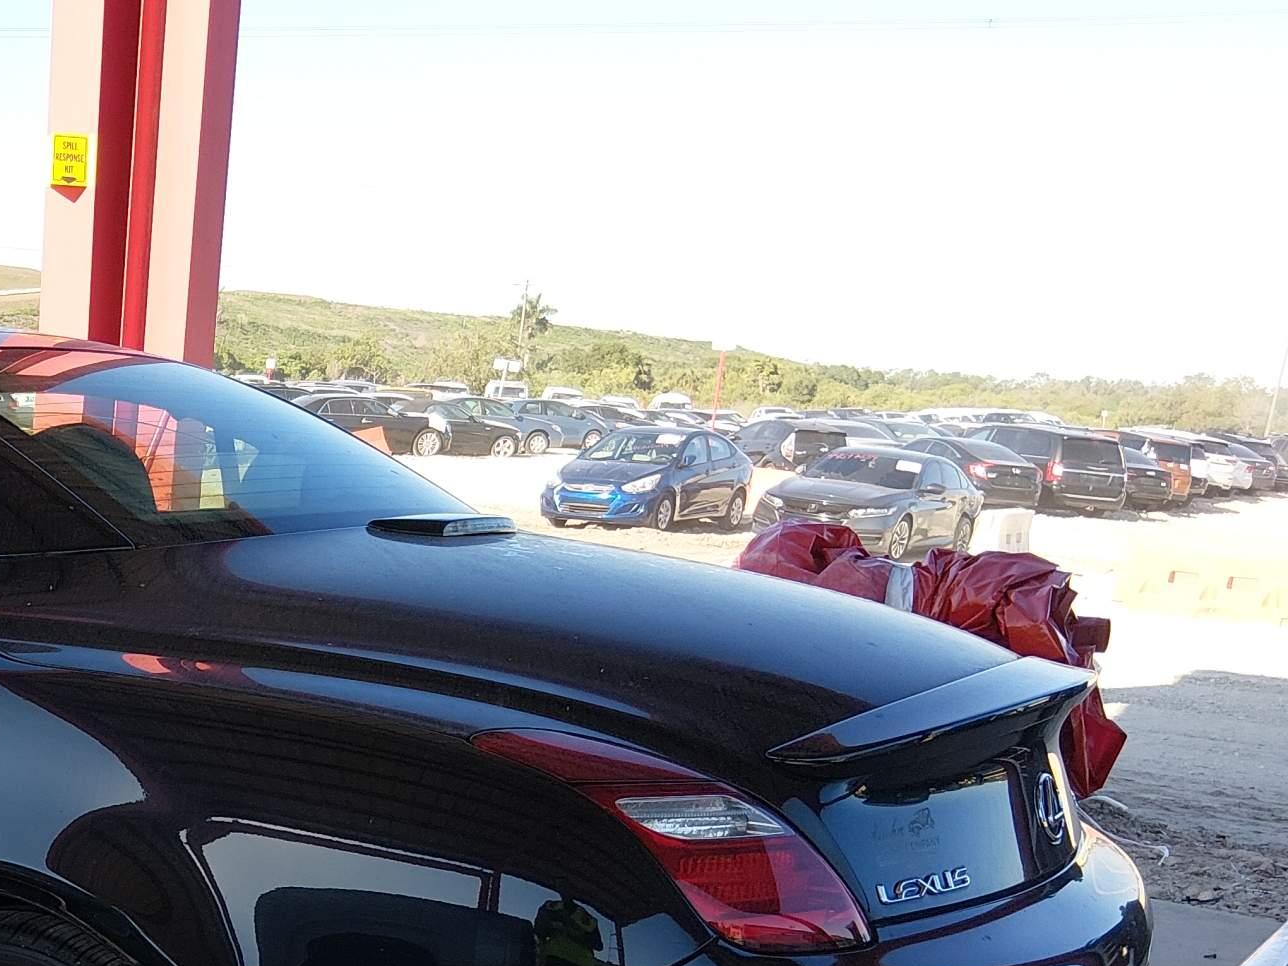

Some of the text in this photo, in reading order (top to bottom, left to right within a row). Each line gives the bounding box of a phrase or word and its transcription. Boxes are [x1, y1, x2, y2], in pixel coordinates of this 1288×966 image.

[62, 141, 78, 151] SPILL
[56, 153, 85, 163] RESPONSE
[64, 165, 74, 173] KIT
[876, 866, 971, 904] LEXUS
